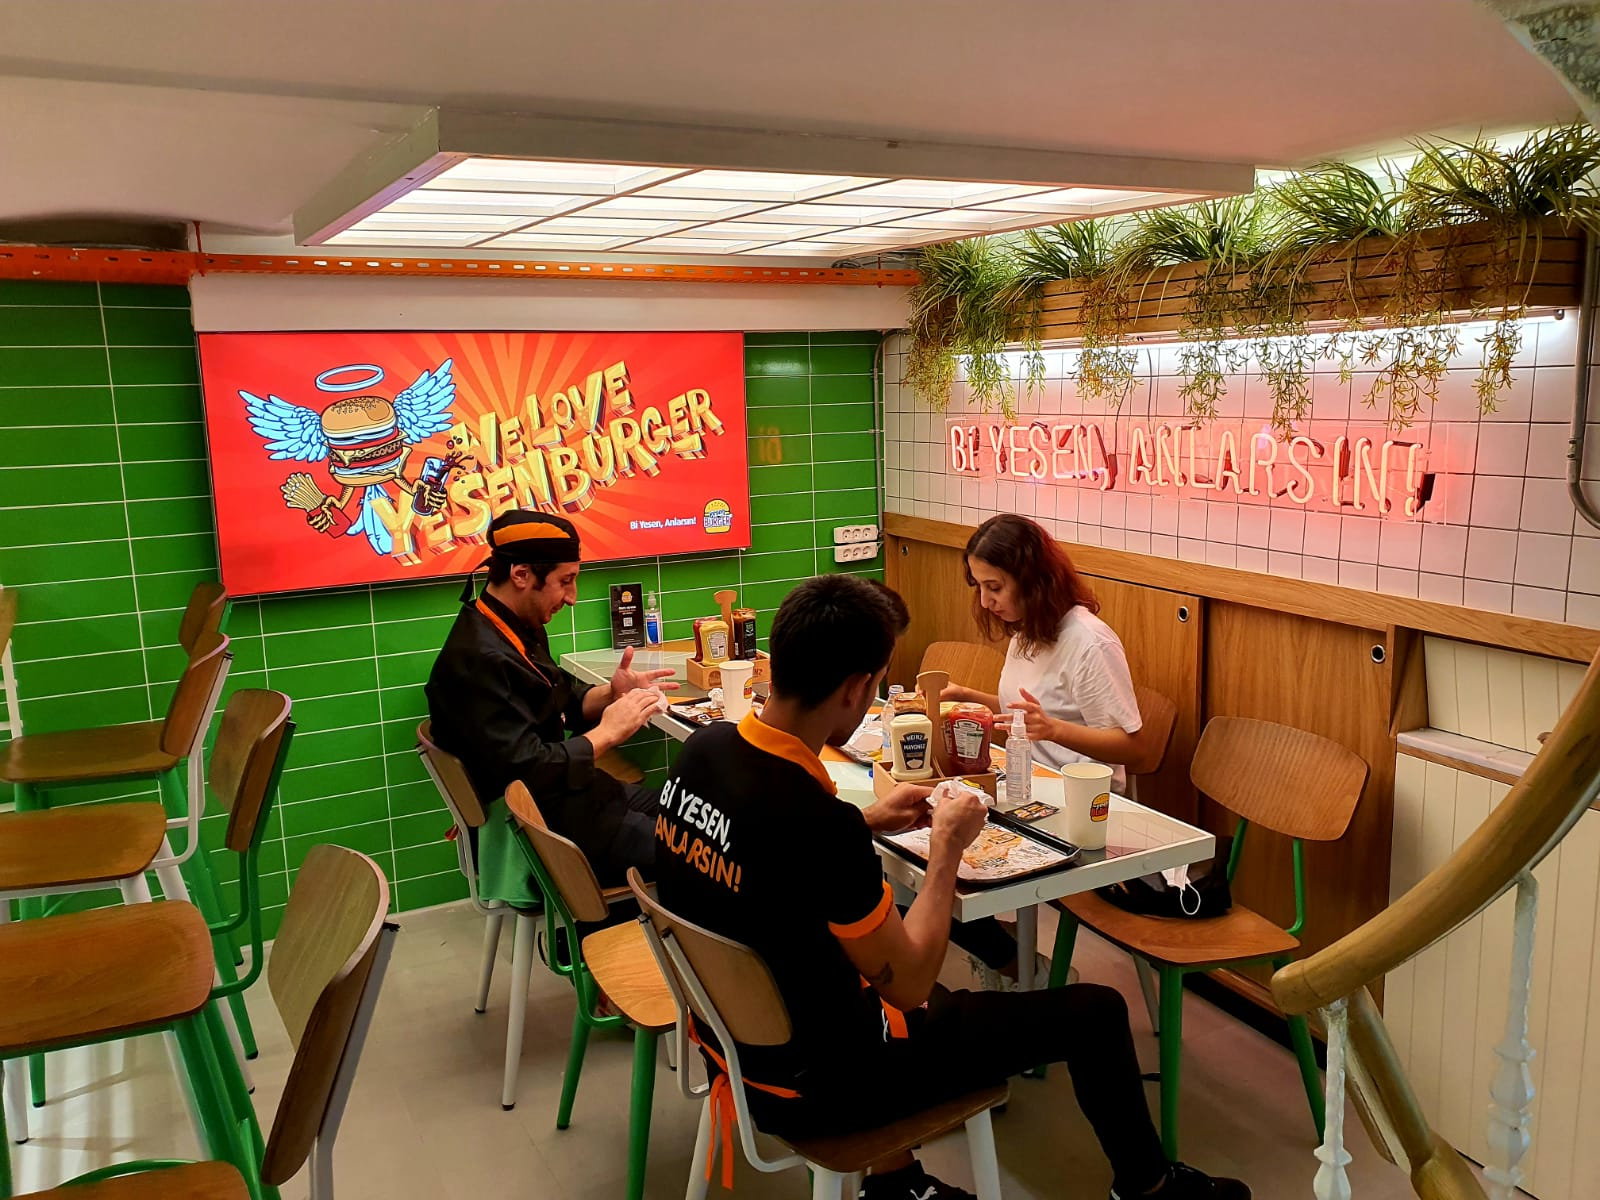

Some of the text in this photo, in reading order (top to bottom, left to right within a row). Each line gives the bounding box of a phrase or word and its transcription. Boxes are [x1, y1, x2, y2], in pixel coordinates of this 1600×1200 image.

[450, 360, 634, 474] WE LOVE
[1128, 424, 1424, 517] ANLARSIN!
[630, 520, 639, 530] Bi
[906, 733, 924, 741] HEINZ
[655, 812, 742, 893] ANLARSIN!
[677, 788, 731, 853] YESEN,
